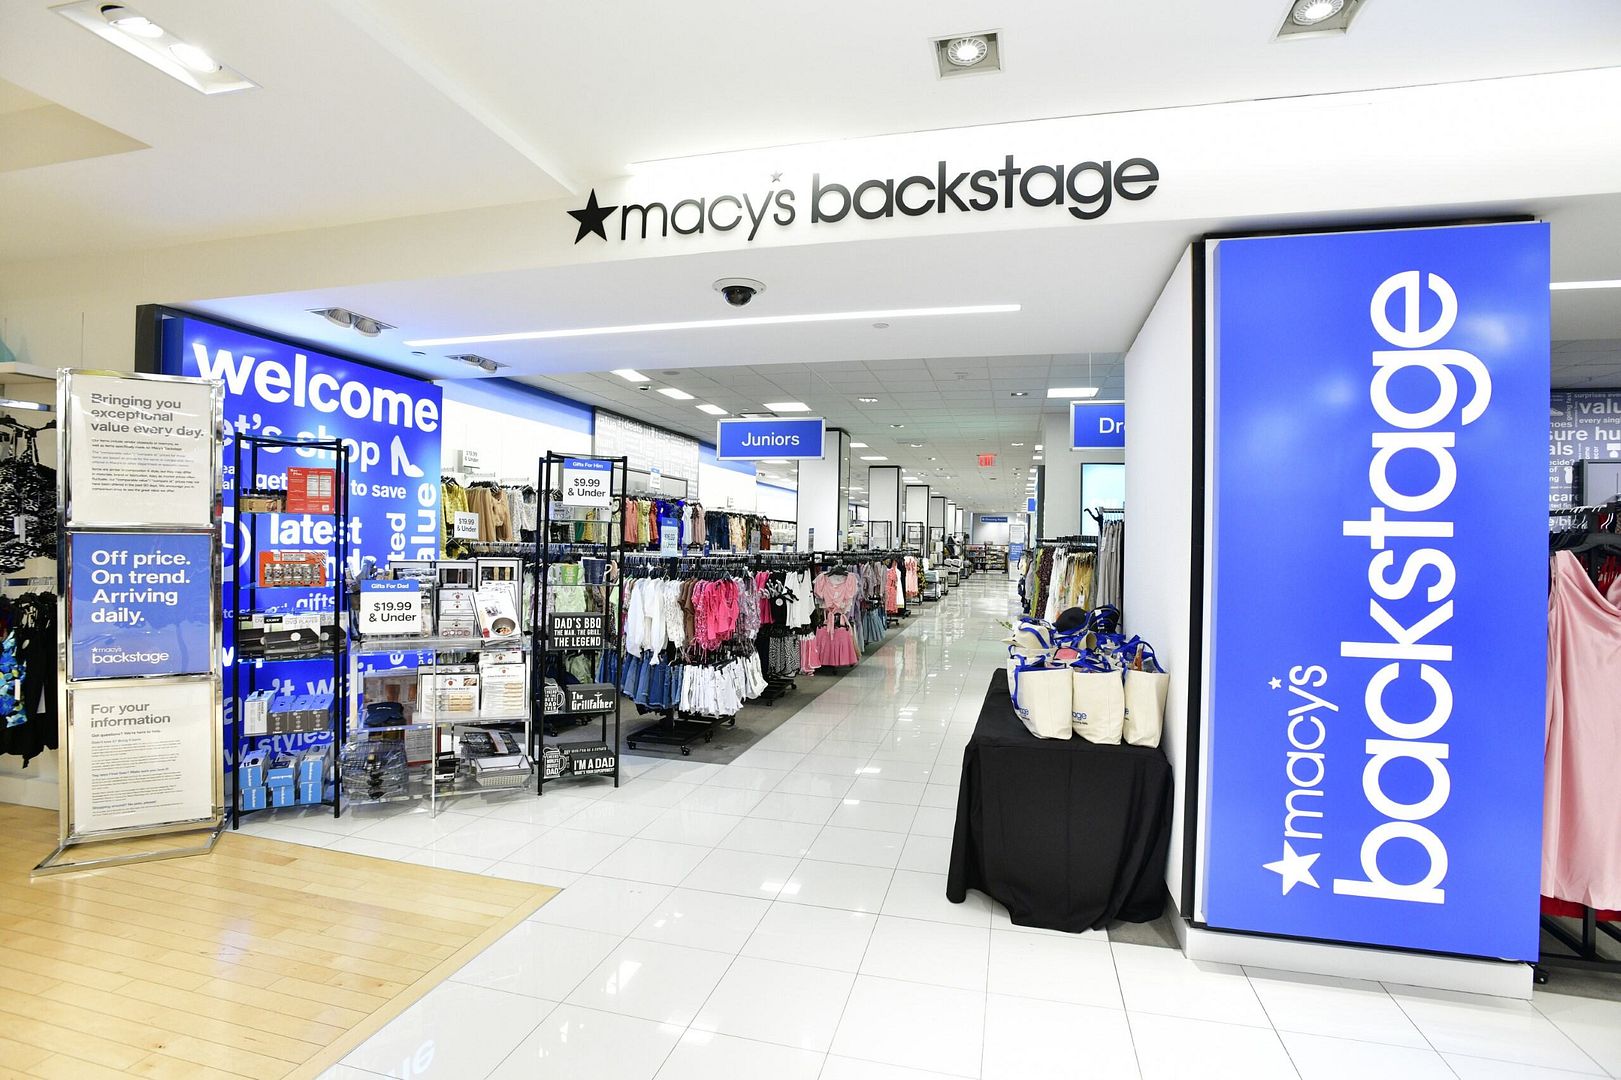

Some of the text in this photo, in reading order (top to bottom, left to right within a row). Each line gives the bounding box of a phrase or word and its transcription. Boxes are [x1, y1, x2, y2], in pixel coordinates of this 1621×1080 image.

[810, 154, 1160, 220] backstage
[191, 342, 438, 433] welcome
[91, 393, 181, 409] Bringing you
[91, 409, 174, 421] exceptional
[91, 421, 204, 438] value every day.
[1099, 417, 1125, 434] Dr
[222, 413, 283, 454] et's
[741, 432, 800, 447] Juniors
[351, 479, 407, 499] to save
[574, 478, 600, 488] $9.99
[567, 488, 606, 498] & Under
[410, 481, 437, 561] alue
[461, 525, 477, 533] Under
[91, 550, 191, 568] Off price.
[91, 569, 191, 584] On trend.
[1332, 270, 1493, 905] backstage
[92, 588, 178, 606] Arriving
[373, 601, 412, 612] $19.99
[91, 607, 145, 625] daily.
[369, 613, 417, 623] & Under
[554, 617, 602, 629] DAD'S BBQ
[554, 636, 601, 647] THE LEGEND
[92, 651, 169, 664] backstage
[571, 691, 583, 700] The
[91, 703, 150, 715] For your
[91, 714, 171, 728] information
[546, 767, 559, 775] DAD
[573, 759, 587, 771] I'M
[587, 758, 594, 769] A
[595, 757, 615, 769] DAD
